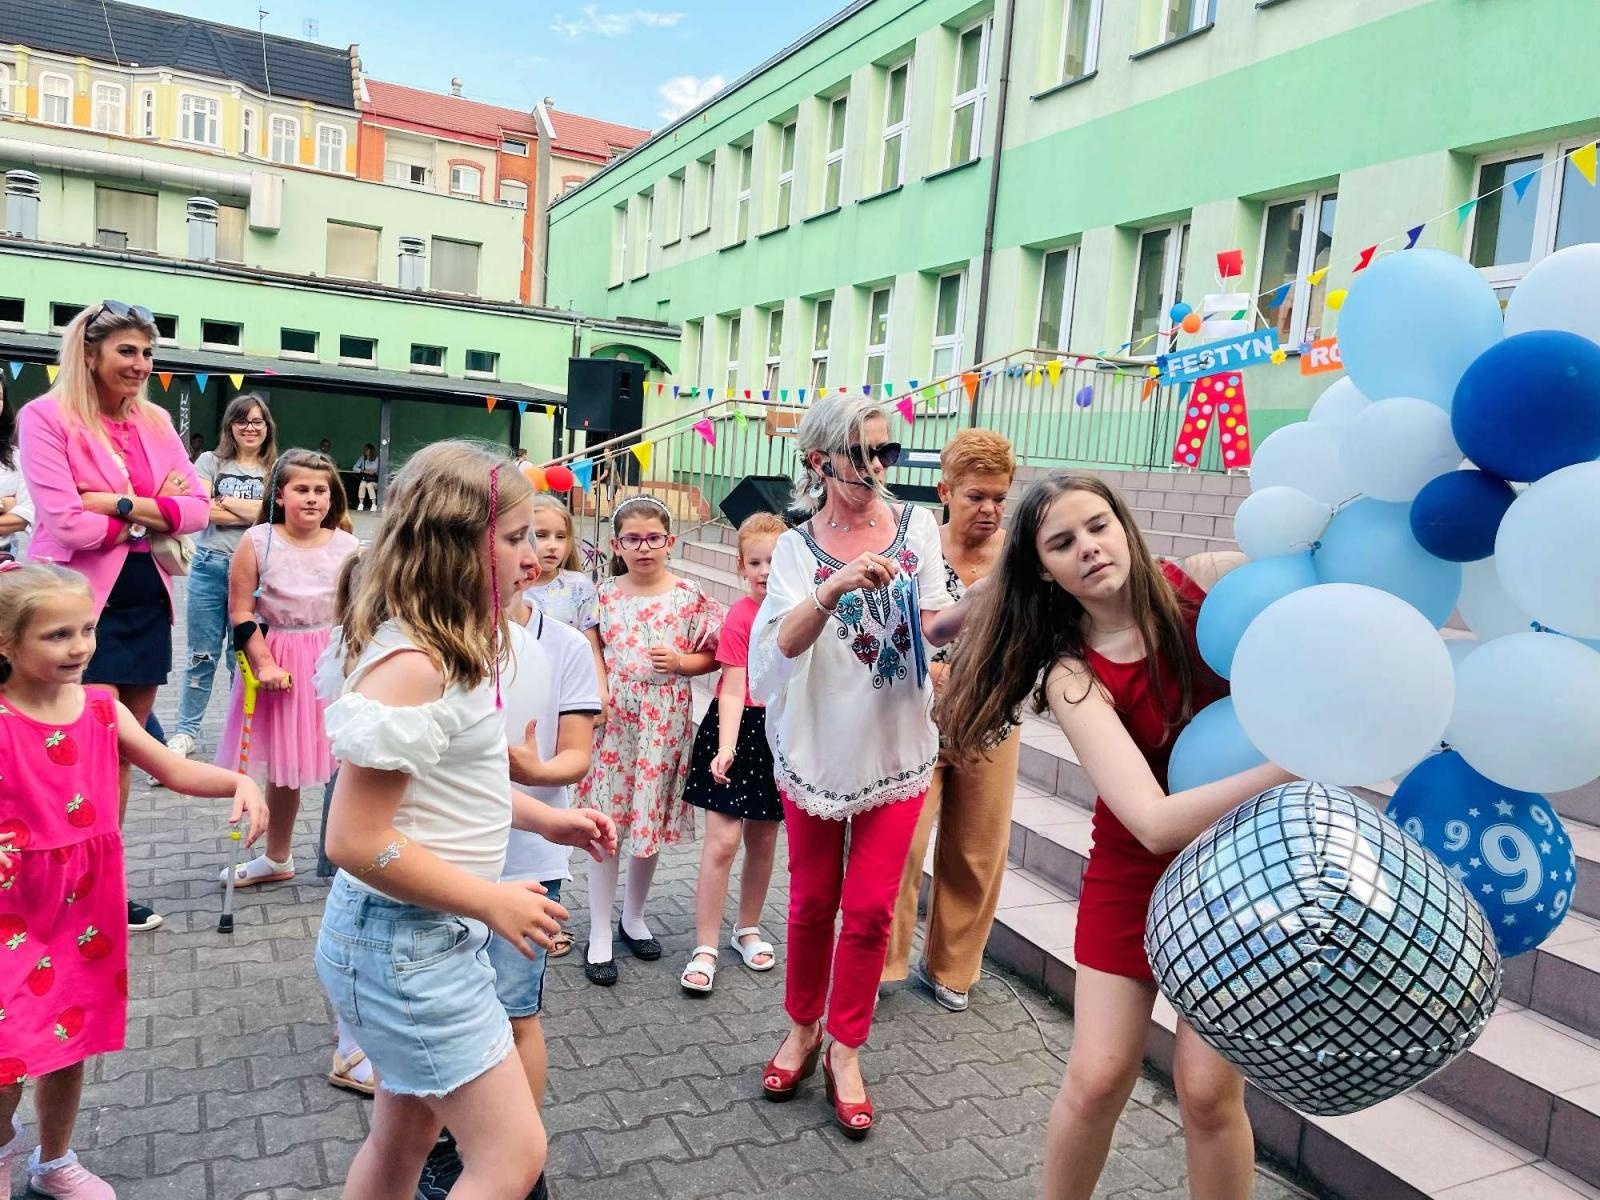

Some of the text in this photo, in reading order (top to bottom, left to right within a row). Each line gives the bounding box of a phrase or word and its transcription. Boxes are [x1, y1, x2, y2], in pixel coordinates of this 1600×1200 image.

[1167, 335, 1273, 378] FESTYN
[1444, 819, 1470, 851] 9
[1529, 804, 1554, 835] 9
[1480, 823, 1543, 905] 9
[1549, 889, 1567, 919] 9
